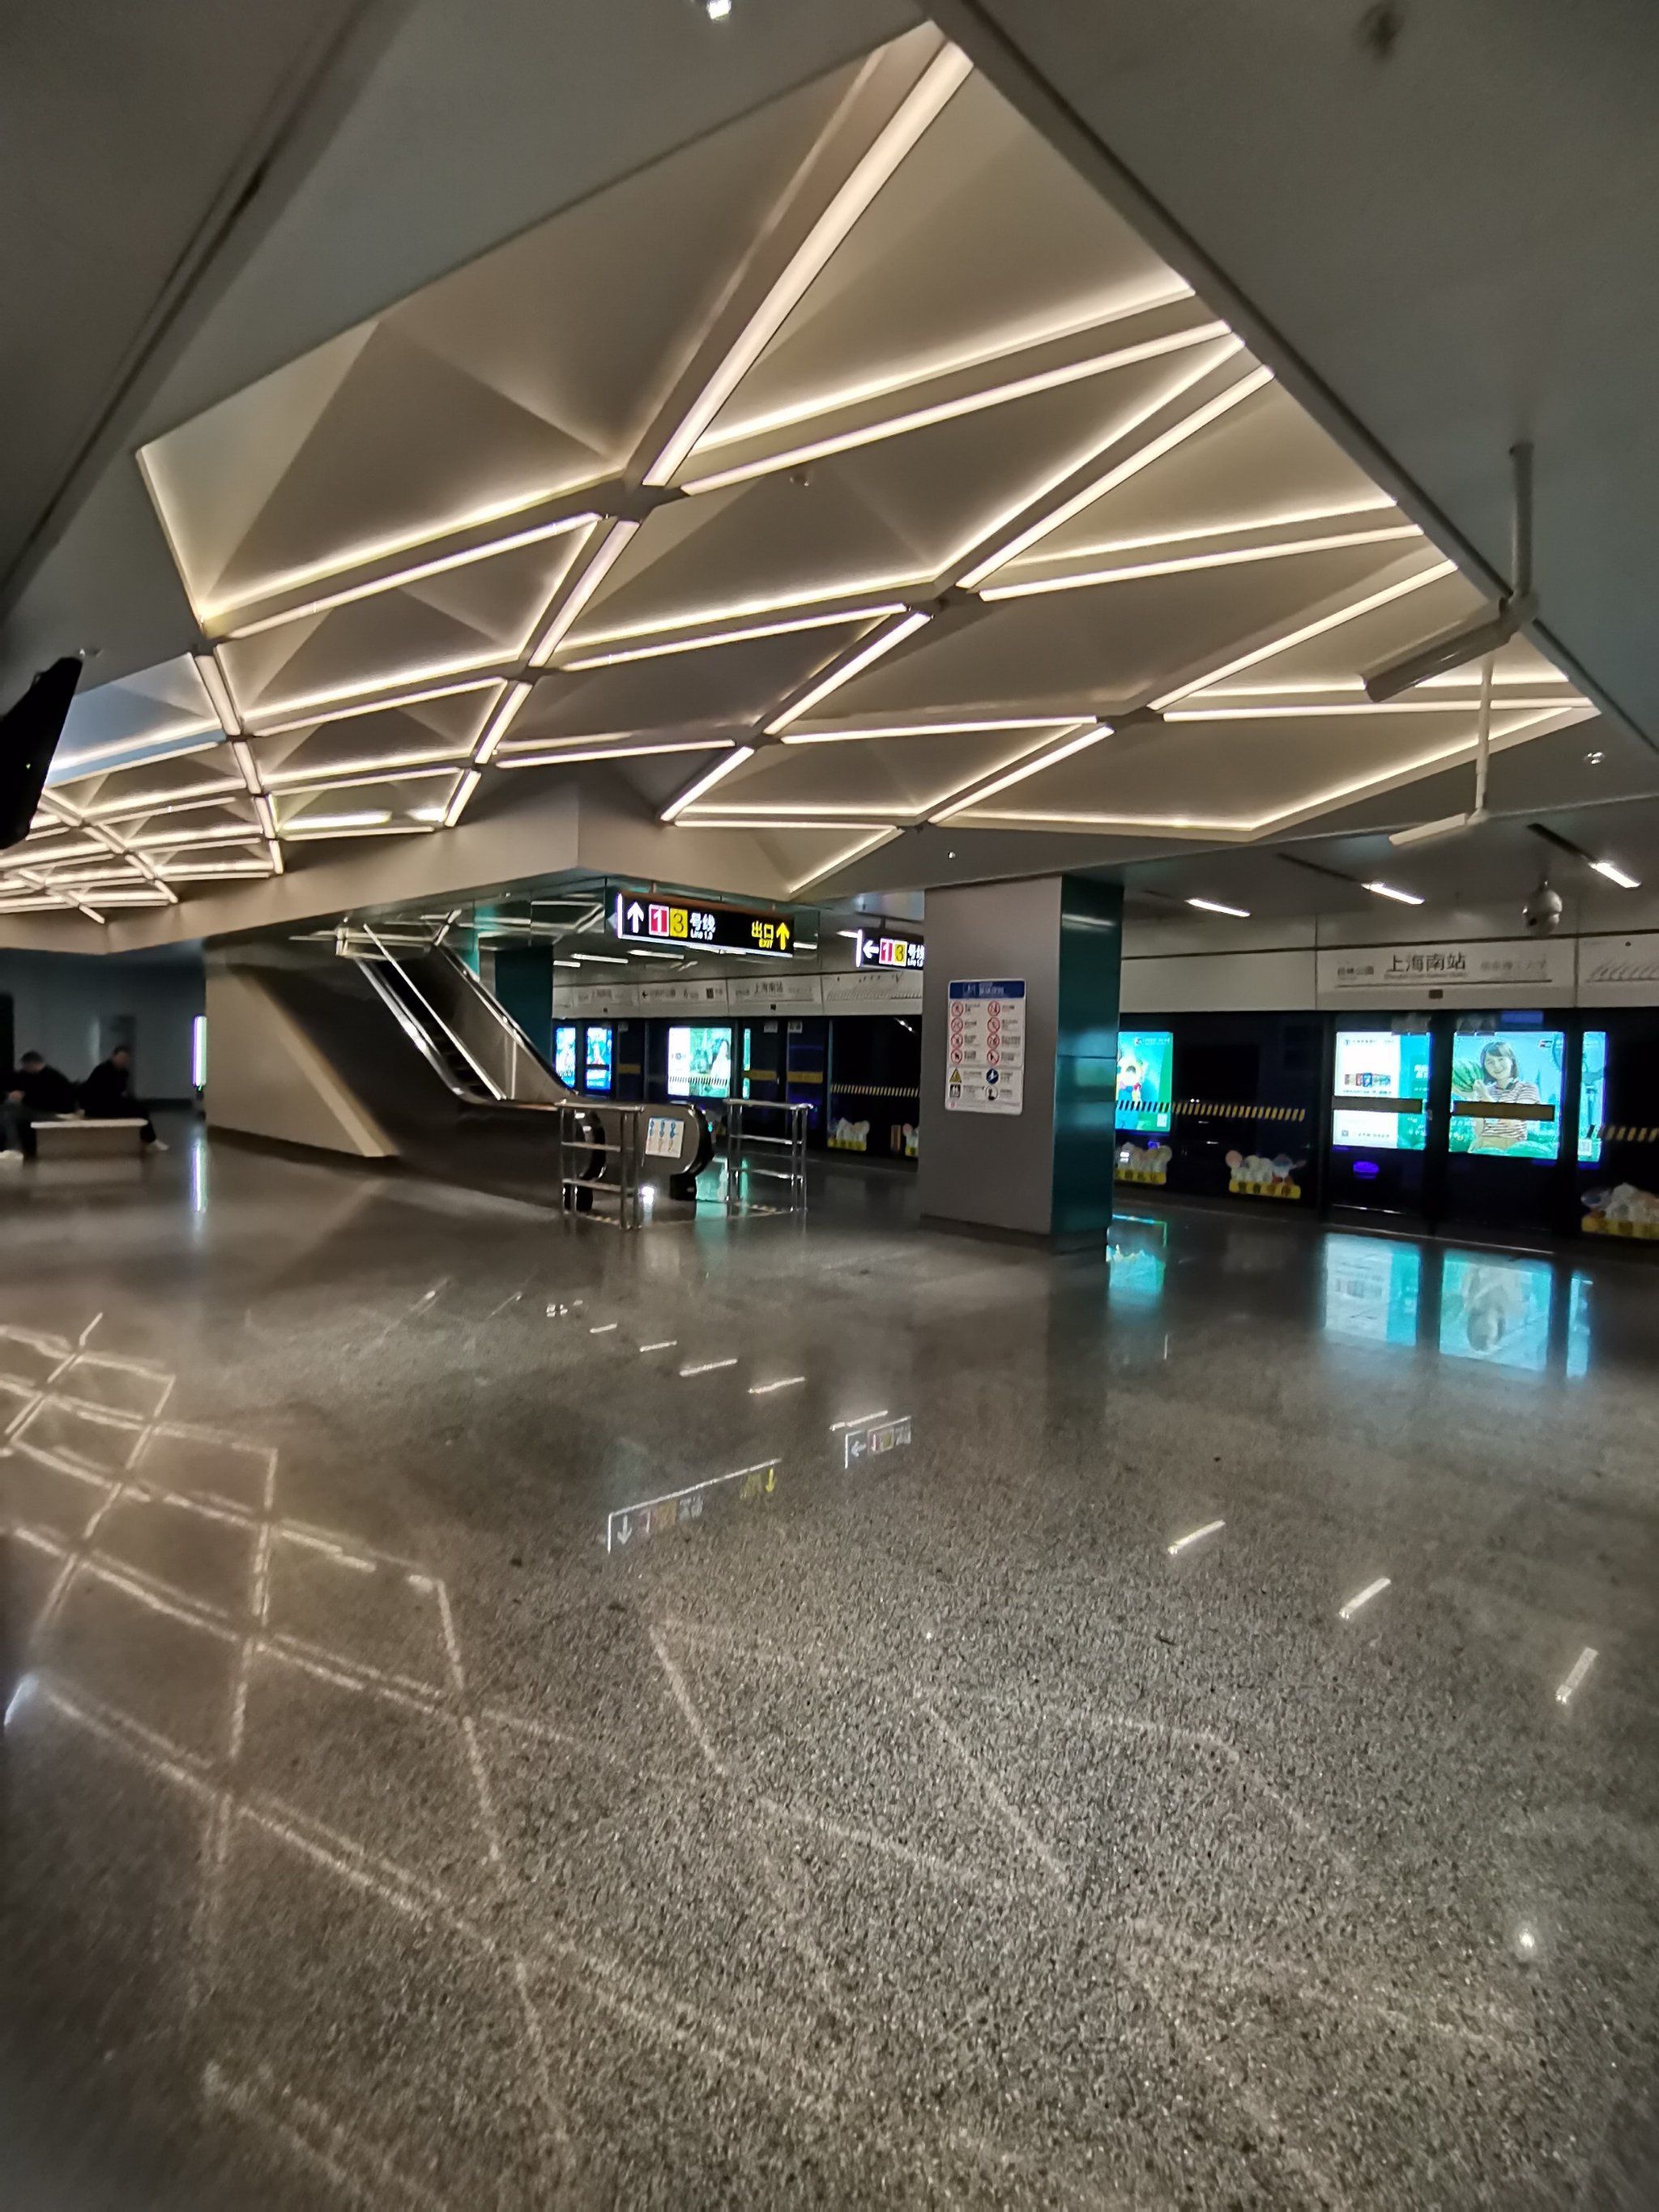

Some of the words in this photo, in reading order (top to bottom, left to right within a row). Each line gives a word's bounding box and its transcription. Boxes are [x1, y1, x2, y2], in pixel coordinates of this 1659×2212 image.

[751, 920, 774, 940] 出口
[1388, 952, 1467, 972] 上海南站
